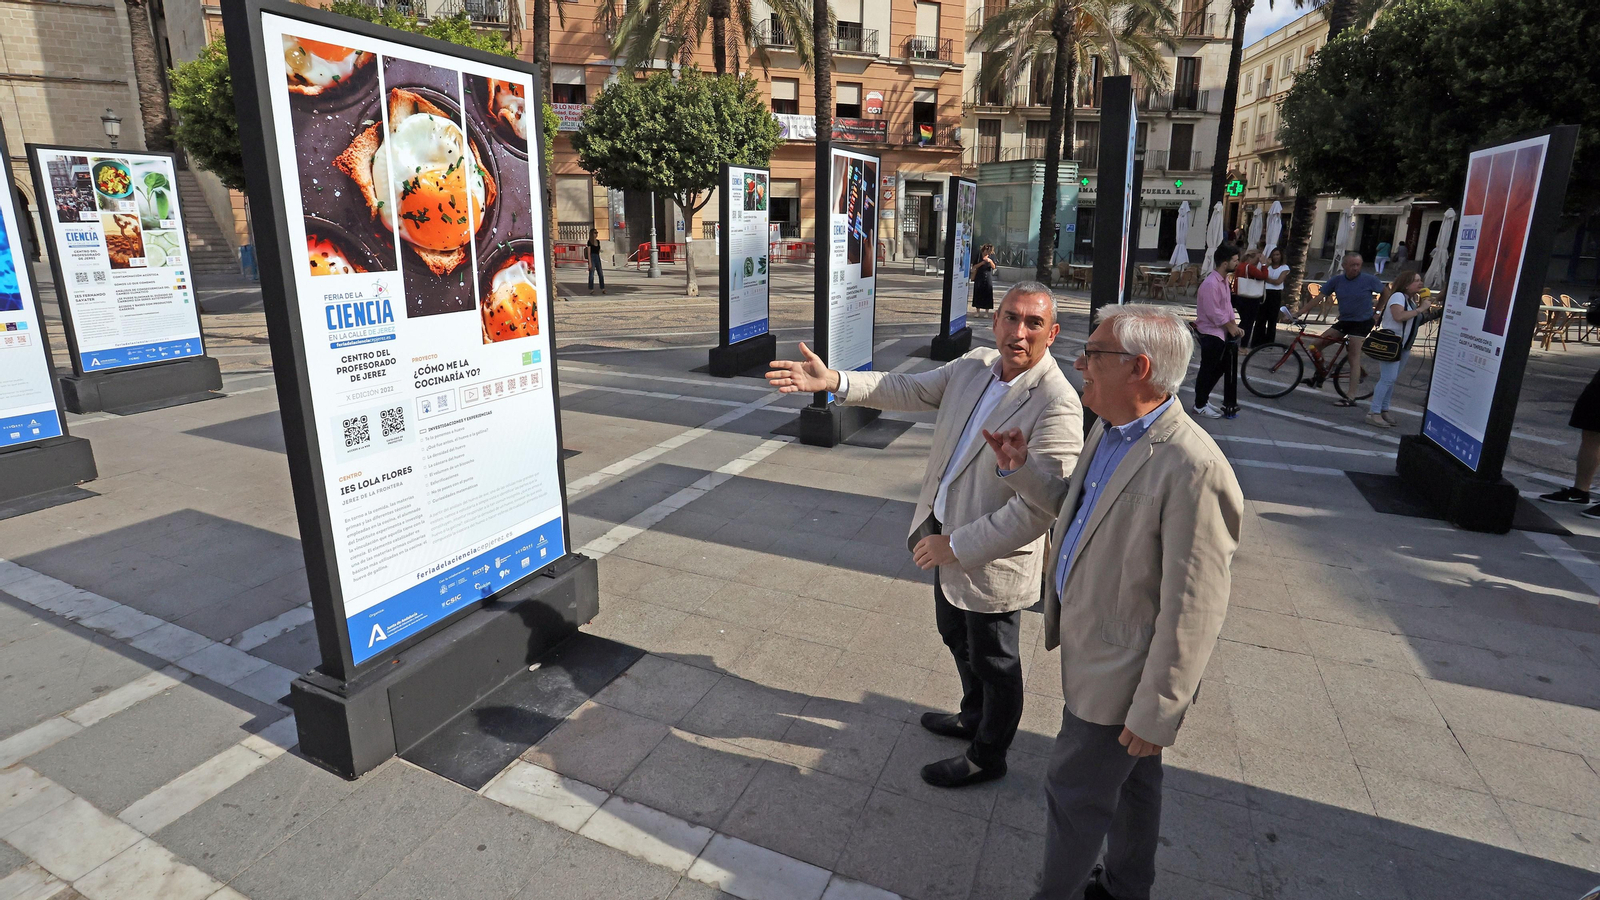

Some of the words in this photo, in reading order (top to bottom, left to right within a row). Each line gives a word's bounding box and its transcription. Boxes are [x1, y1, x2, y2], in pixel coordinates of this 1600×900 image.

[66, 232, 99, 241] CIENCIA
[325, 299, 394, 331] CIENCIA
[348, 330, 367, 338] CALLE
[341, 352, 375, 364] CENTRO
[376, 349, 390, 358] DEL
[412, 354, 438, 363] PROYECTO
[336, 358, 396, 375] PROFESORADO
[413, 362, 445, 379] ¿CÓMO
[446, 361, 457, 370] ME
[459, 359, 469, 367] LA
[350, 374, 361, 382] DE
[362, 369, 386, 380] JEREZ
[414, 370, 464, 390] COCINARÍA
[466, 368, 480, 378] YO?
[352, 388, 379, 400] EDICIÓN
[428, 419, 463, 432] INVESTIGACIONES
[467, 410, 492, 421] EXPERIENCIAS
[339, 471, 362, 482] CENTRO
[341, 484, 356, 495] IES
[358, 476, 380, 490] LOLA
[382, 466, 412, 482] FLORES
[342, 496, 359, 506] JEREZ
[377, 481, 403, 494] FRONTERA
[417, 530, 513, 582] feriadelacienciacepjerez.es
[446, 594, 462, 606] CSIC
